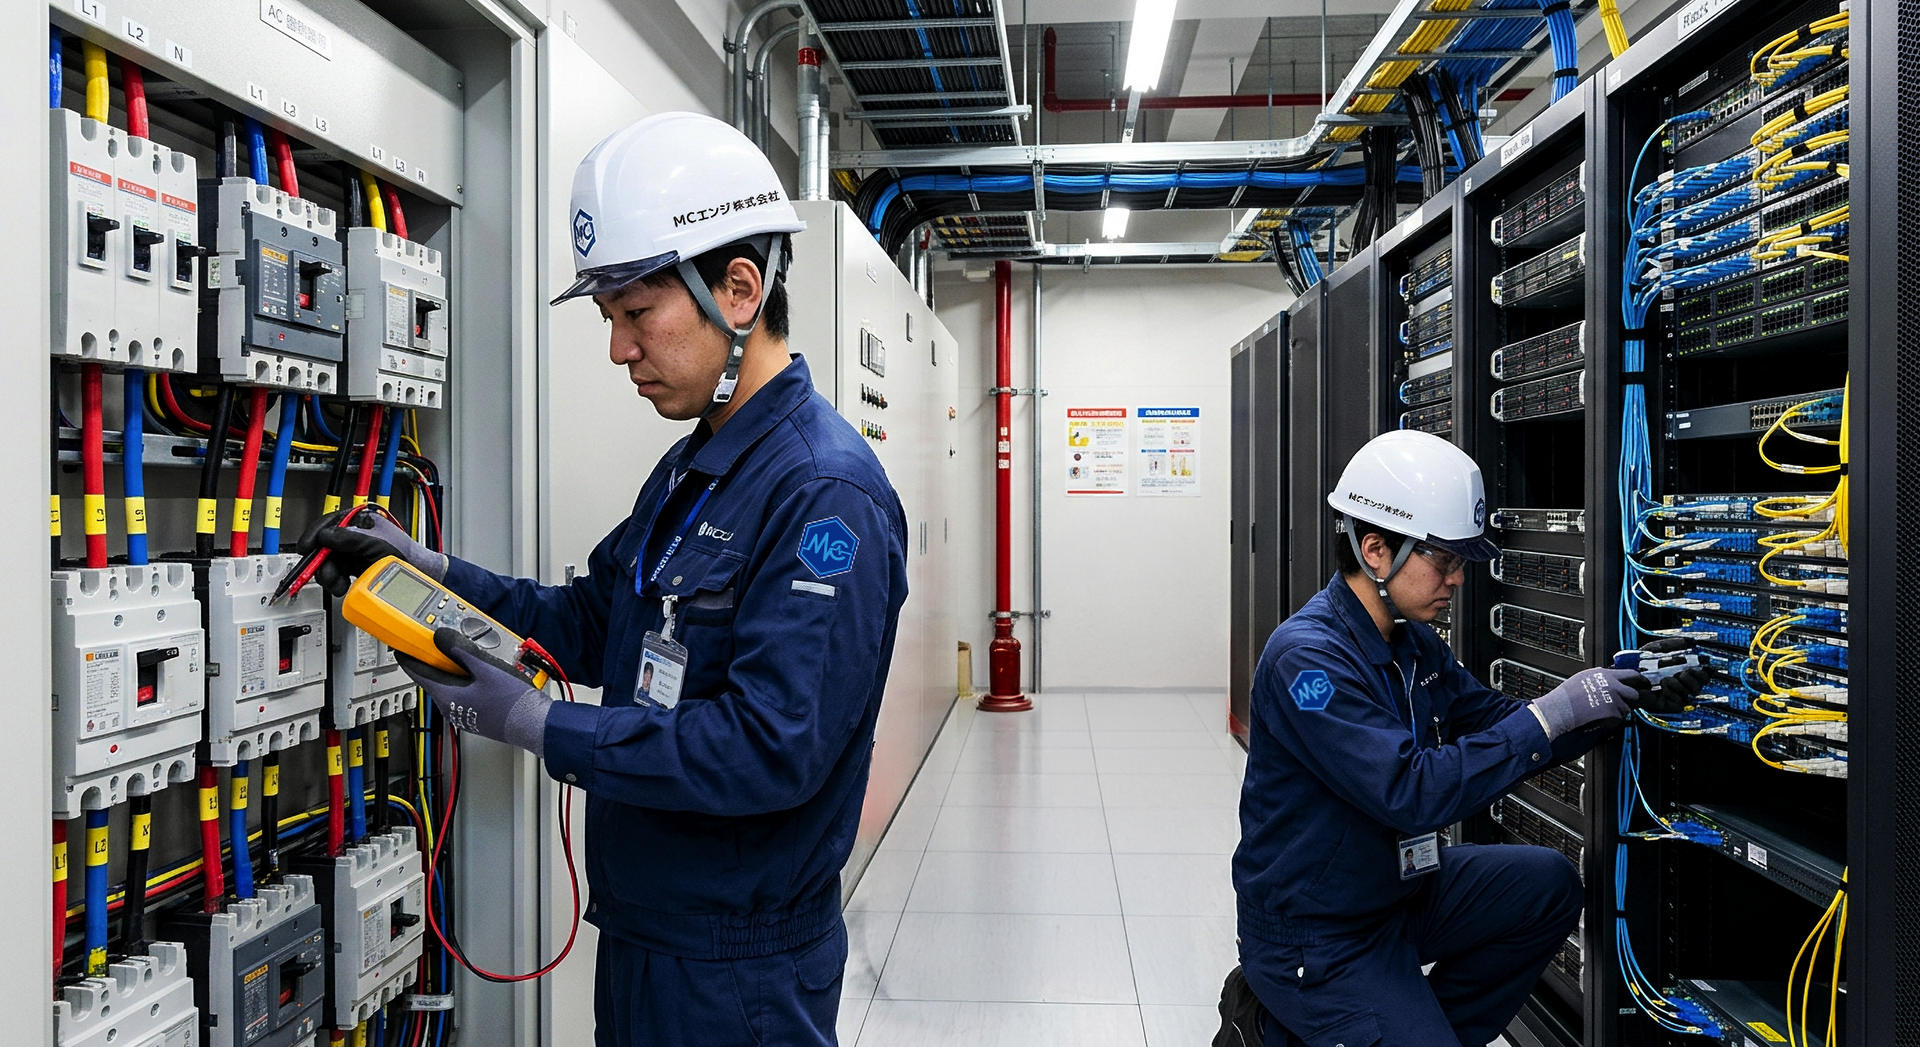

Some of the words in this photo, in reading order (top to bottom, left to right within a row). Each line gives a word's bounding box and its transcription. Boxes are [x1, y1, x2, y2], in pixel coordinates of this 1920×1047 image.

[82, 0, 97, 19] L1
[268, 5, 283, 23] AC
[127, 22, 144, 43] L2
[174, 46, 183, 62] N
[250, 85, 263, 101] L1
[315, 117, 327, 132] L3
[672, 190, 780, 228] MCエンジ株式会社
[805, 532, 850, 561] MC
[1298, 678, 1330, 703] MC
